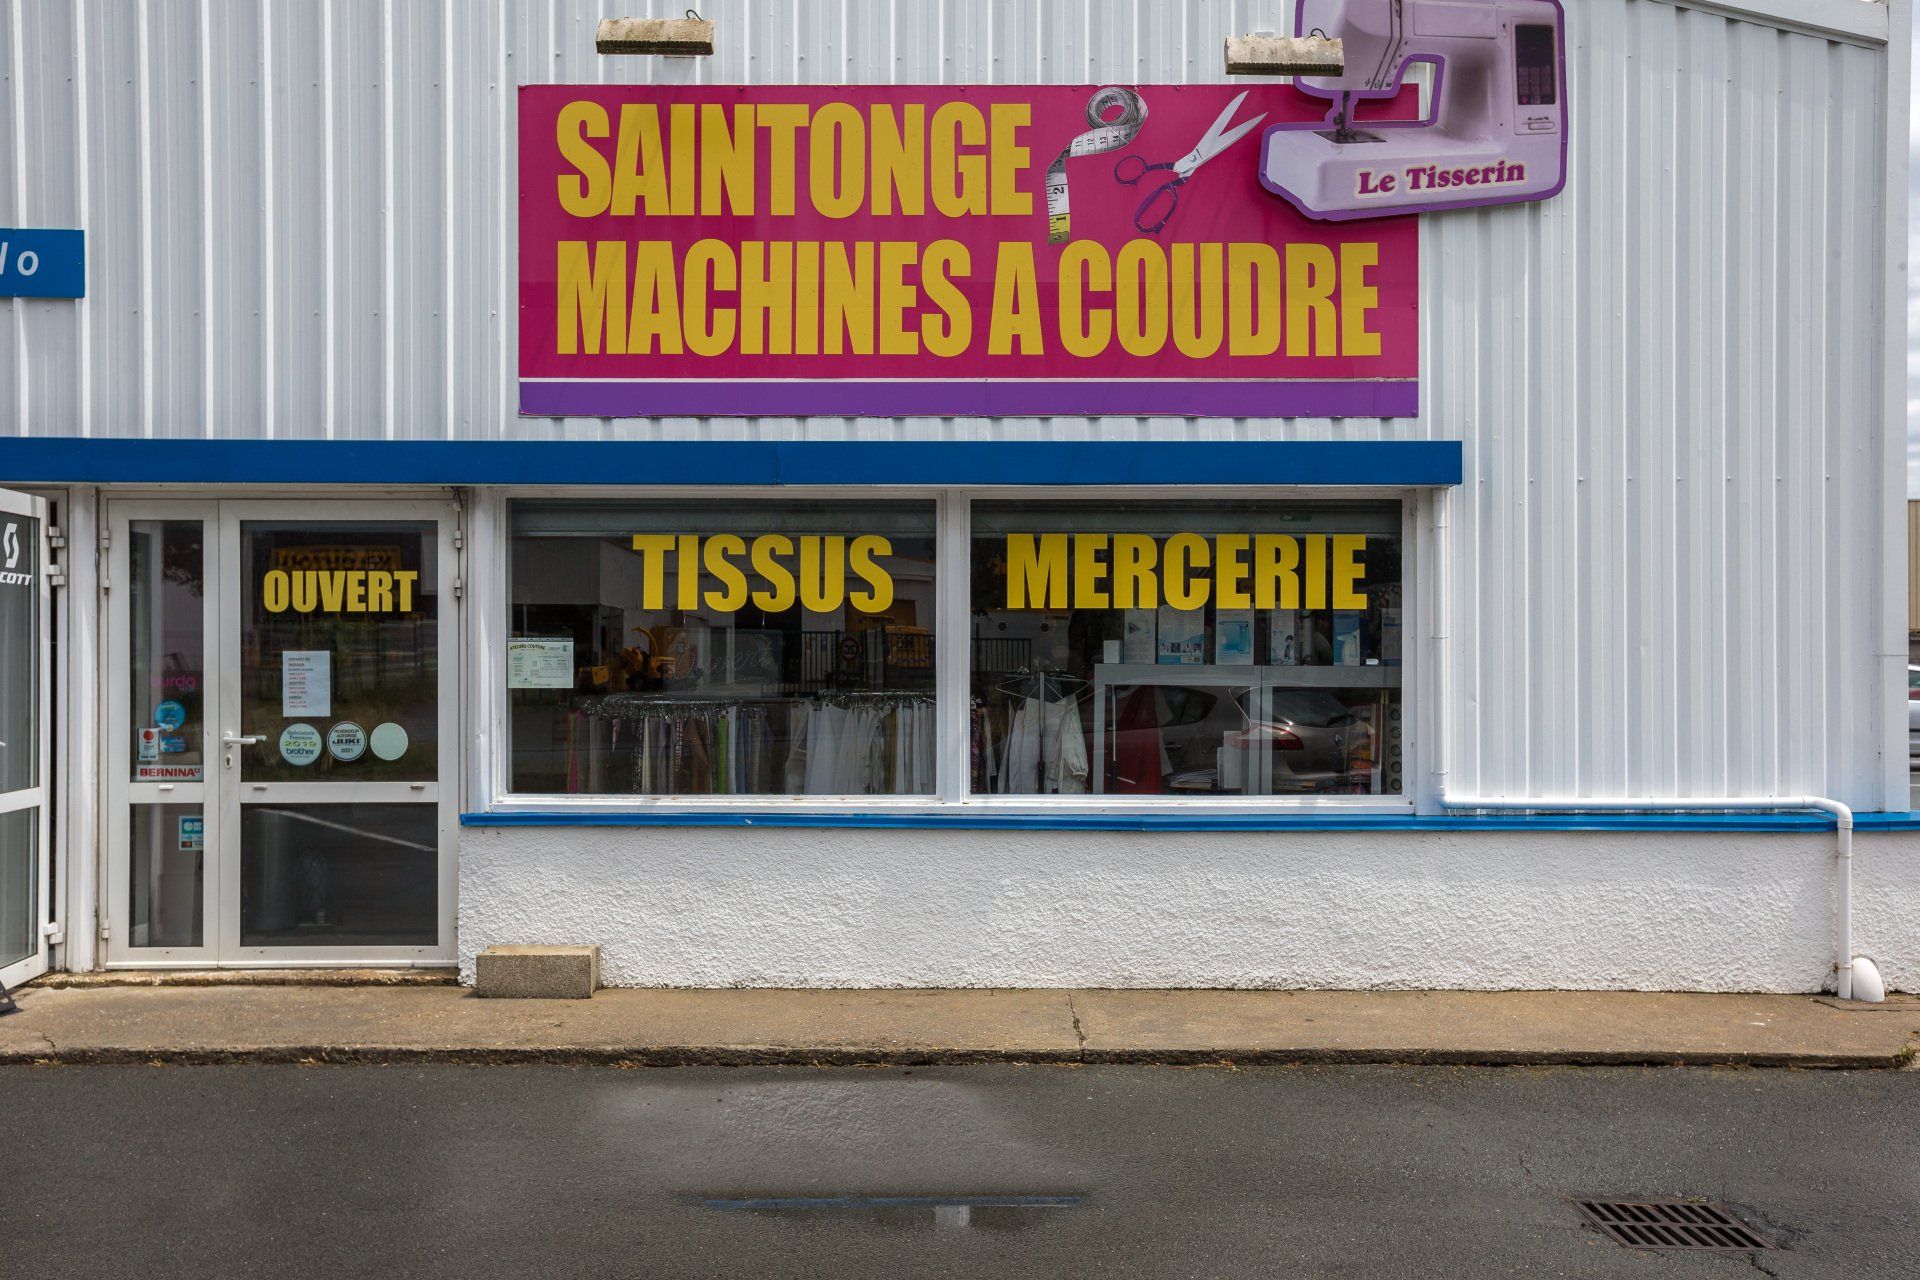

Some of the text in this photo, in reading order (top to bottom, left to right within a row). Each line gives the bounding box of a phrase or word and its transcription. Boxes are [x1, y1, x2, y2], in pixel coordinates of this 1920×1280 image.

[556, 101, 1031, 219] SAINTONGE
[1358, 160, 1525, 195] Le Tisserin
[556, 239, 1382, 358] MACHINES A COUDRE
[263, 569, 418, 613] OUVERT
[633, 534, 894, 613] TISSUS
[1006, 532, 1368, 610] MERCERIE
[139, 766, 196, 777] BERNINA
[286, 747, 315, 755] brother
